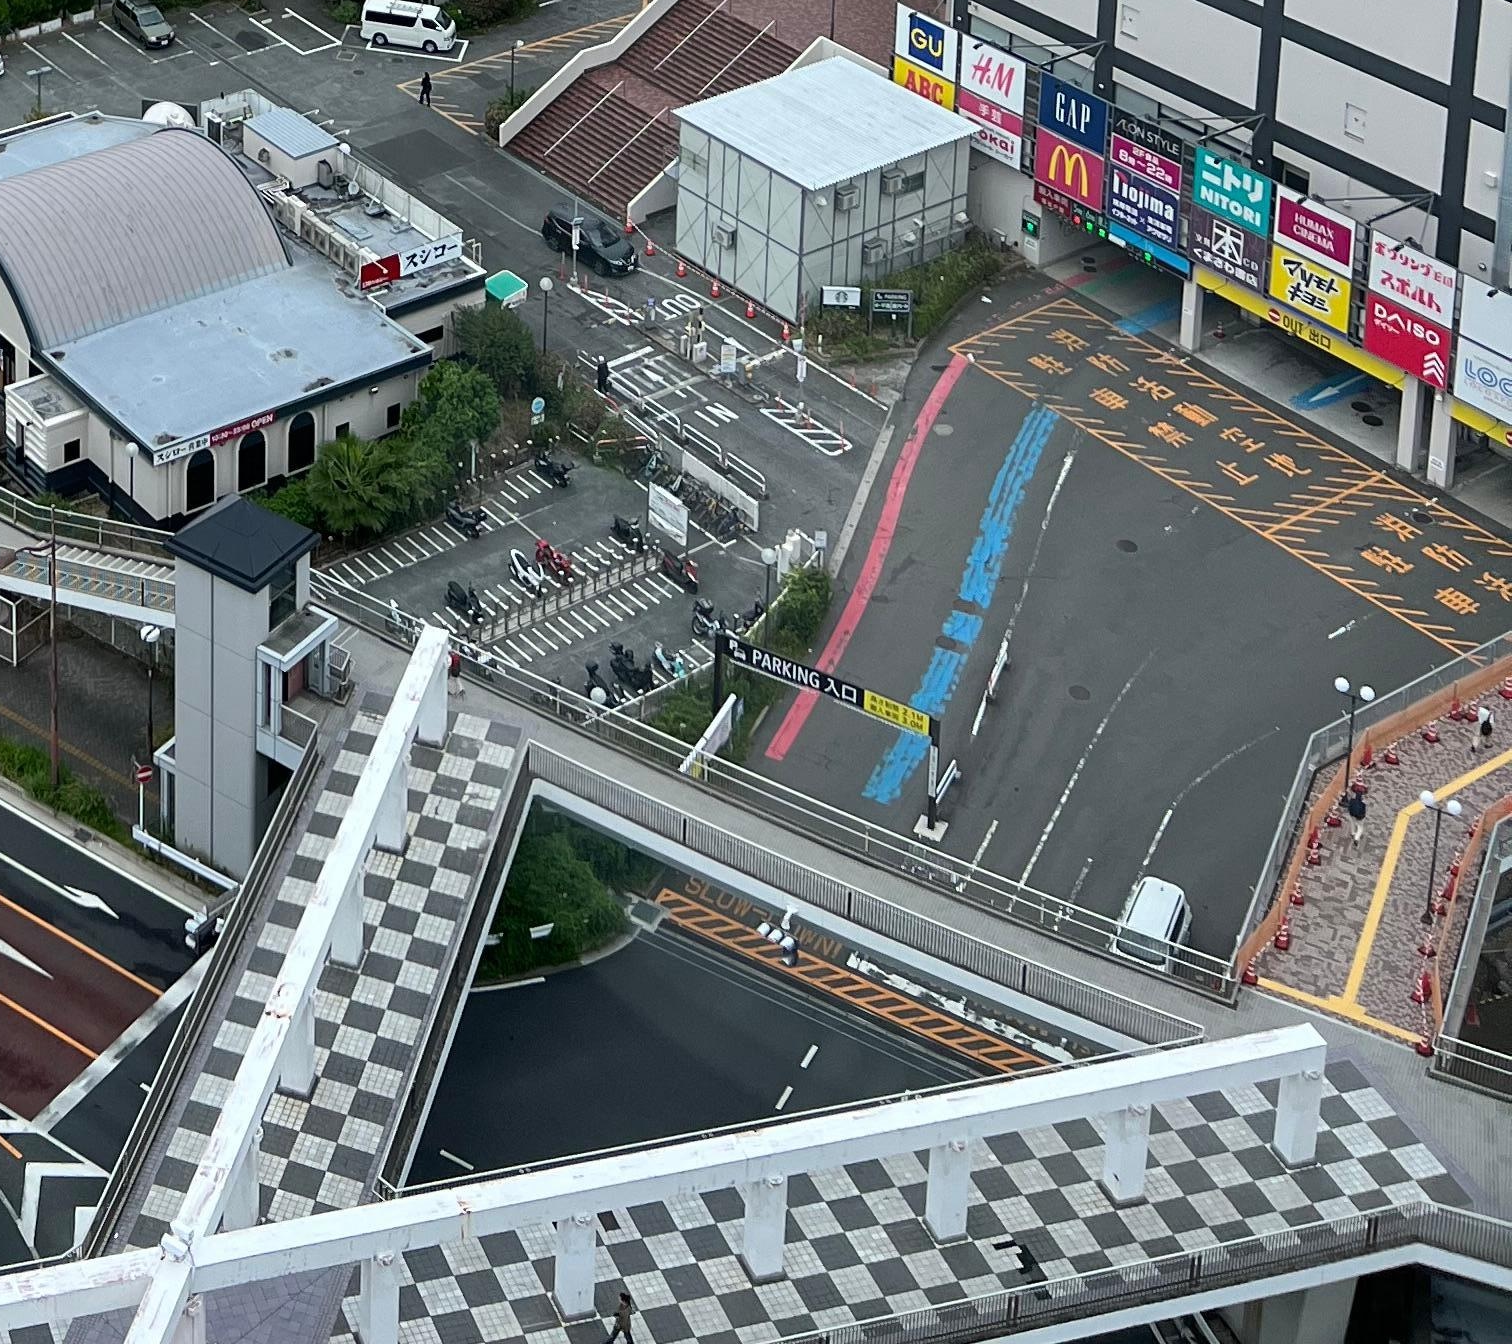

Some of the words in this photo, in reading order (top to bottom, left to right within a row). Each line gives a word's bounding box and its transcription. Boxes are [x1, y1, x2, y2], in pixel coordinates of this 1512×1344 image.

[911, 28, 942, 58] GU
[904, 69, 944, 105] ABC
[971, 53, 1015, 98] H&M
[1055, 92, 1090, 134] GAP
[978, 129, 1015, 155] okai
[1147, 131, 1180, 156] STYLE
[1202, 154, 1264, 203] ニトリ
[1200, 186, 1261, 227] NITORI
[1293, 226, 1335, 253] CINEMA
[1295, 213, 1334, 238] HUMAX
[1243, 257, 1259, 272] CD
[1283, 258, 1339, 295] マツモト
[655, 294, 701, 321] OUT
[1287, 283, 1329, 313] キヨシ
[1283, 316, 1304, 336] OUT
[1308, 328, 1331, 350] 出口
[1374, 302, 1440, 346] DAISO
[251, 414, 274, 428] OPEN
[694, 403, 739, 428] IN
[752, 649, 820, 688] PARKING
[824, 678, 857, 704] 入口
[685, 876, 752, 917] SLOW
